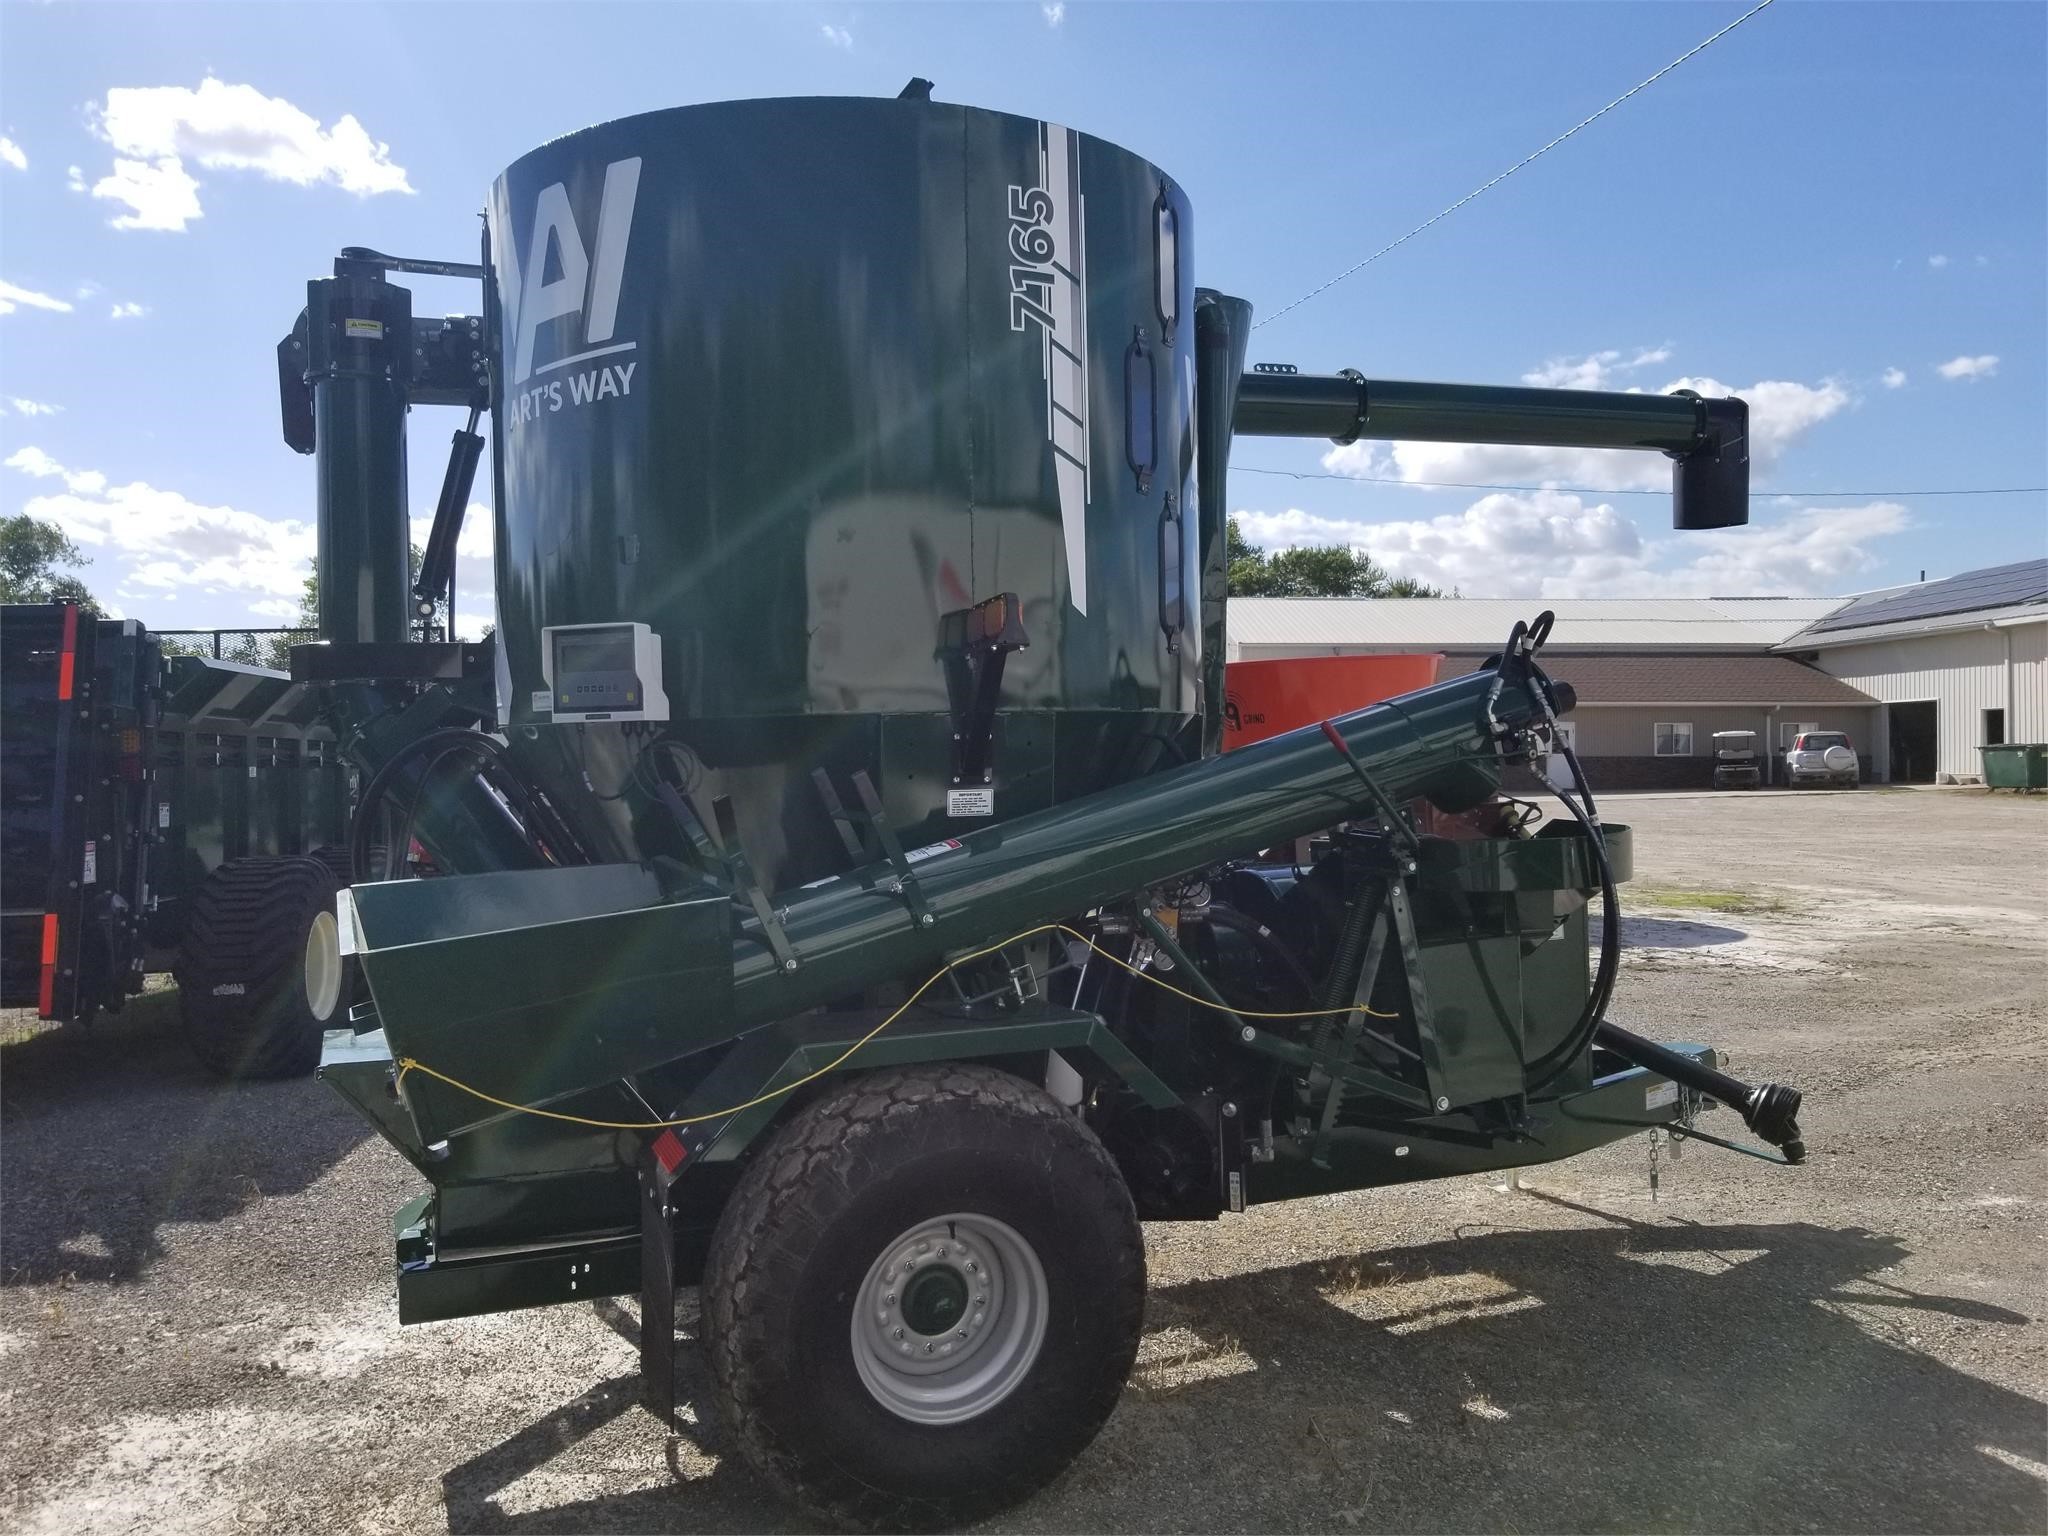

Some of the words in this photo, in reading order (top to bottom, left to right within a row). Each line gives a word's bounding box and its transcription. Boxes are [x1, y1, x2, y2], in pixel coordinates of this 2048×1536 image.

[1008, 184, 1056, 332] 7165
[510, 381, 563, 430] ART'S
[568, 362, 638, 406] WAY
